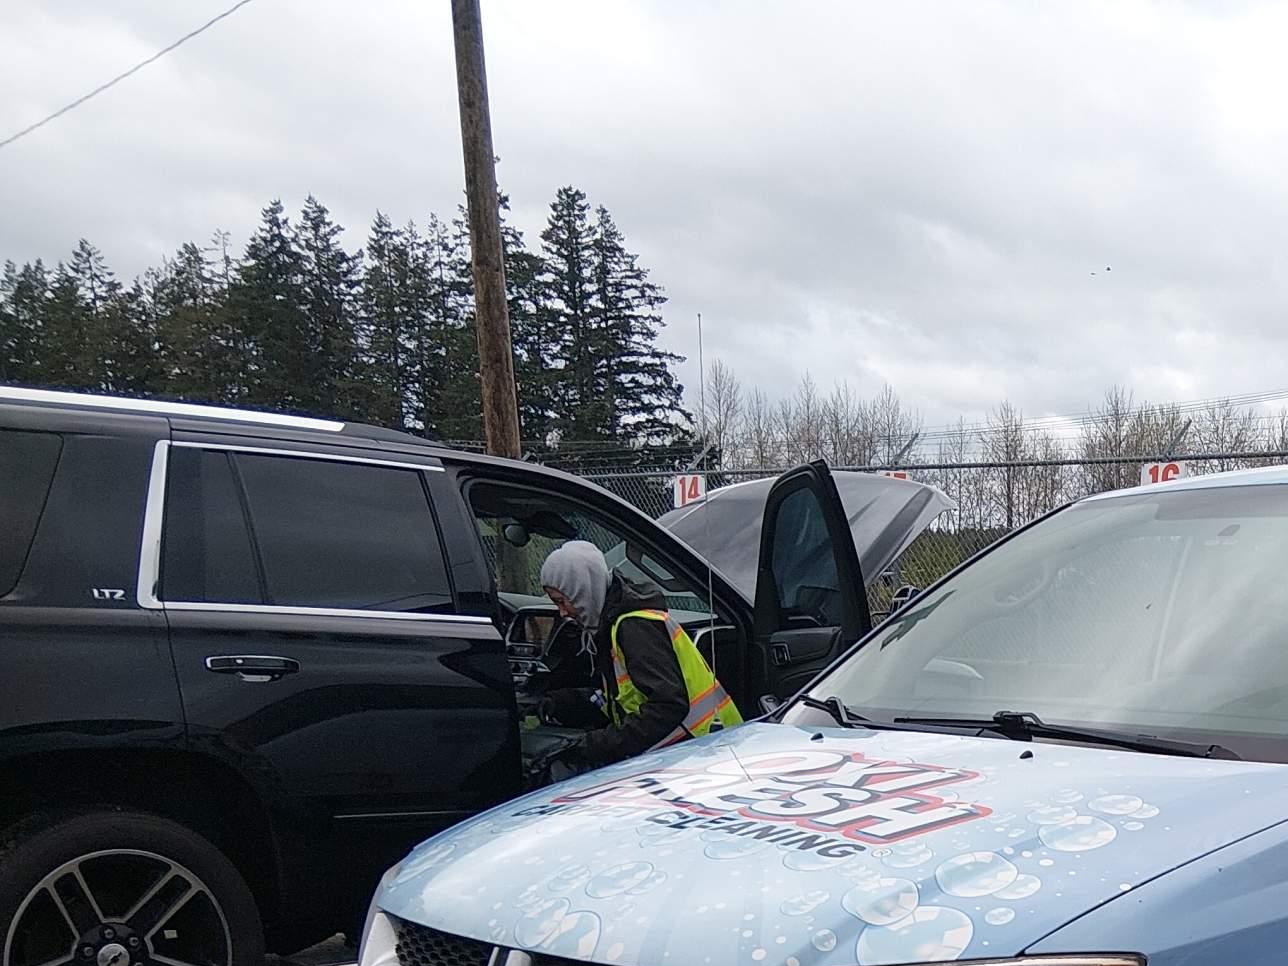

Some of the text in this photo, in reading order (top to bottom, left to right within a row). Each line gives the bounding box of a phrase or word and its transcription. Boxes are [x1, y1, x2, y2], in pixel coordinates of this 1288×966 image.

[679, 476, 701, 505] 14
[92, 588, 127, 601] LTZ
[703, 750, 962, 794] OXI
[558, 771, 972, 839] FRESH
[644, 810, 867, 859] CLEANING
